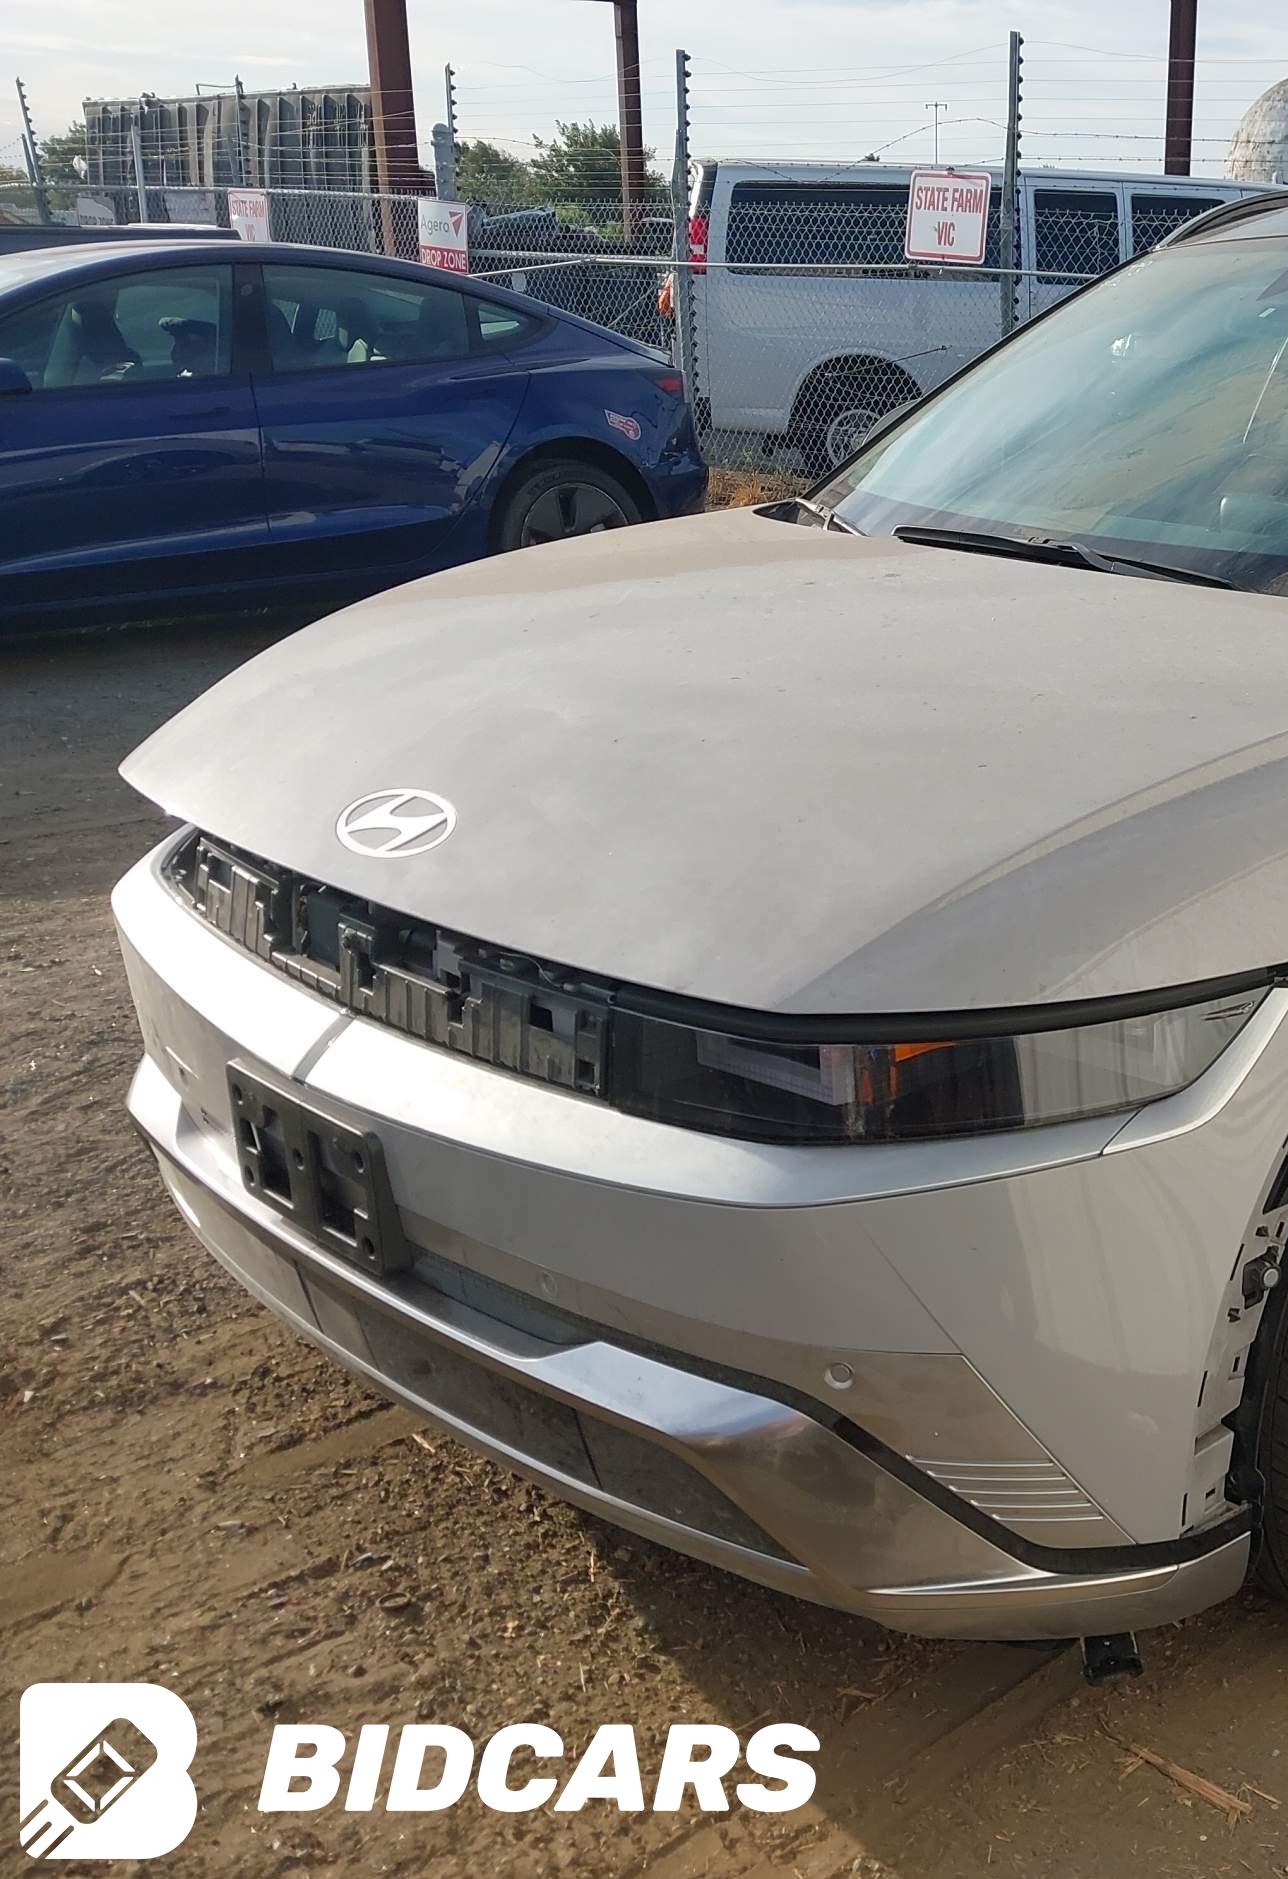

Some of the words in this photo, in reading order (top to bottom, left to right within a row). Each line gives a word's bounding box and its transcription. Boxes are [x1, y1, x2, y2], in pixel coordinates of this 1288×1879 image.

[231, 199, 248, 217] STATE
[915, 186, 949, 210] STATE
[950, 188, 983, 213] FARM
[421, 214, 449, 235] Agero
[936, 221, 955, 246] VIC
[421, 249, 441, 266] DROP
[443, 251, 467, 270] ZONE
